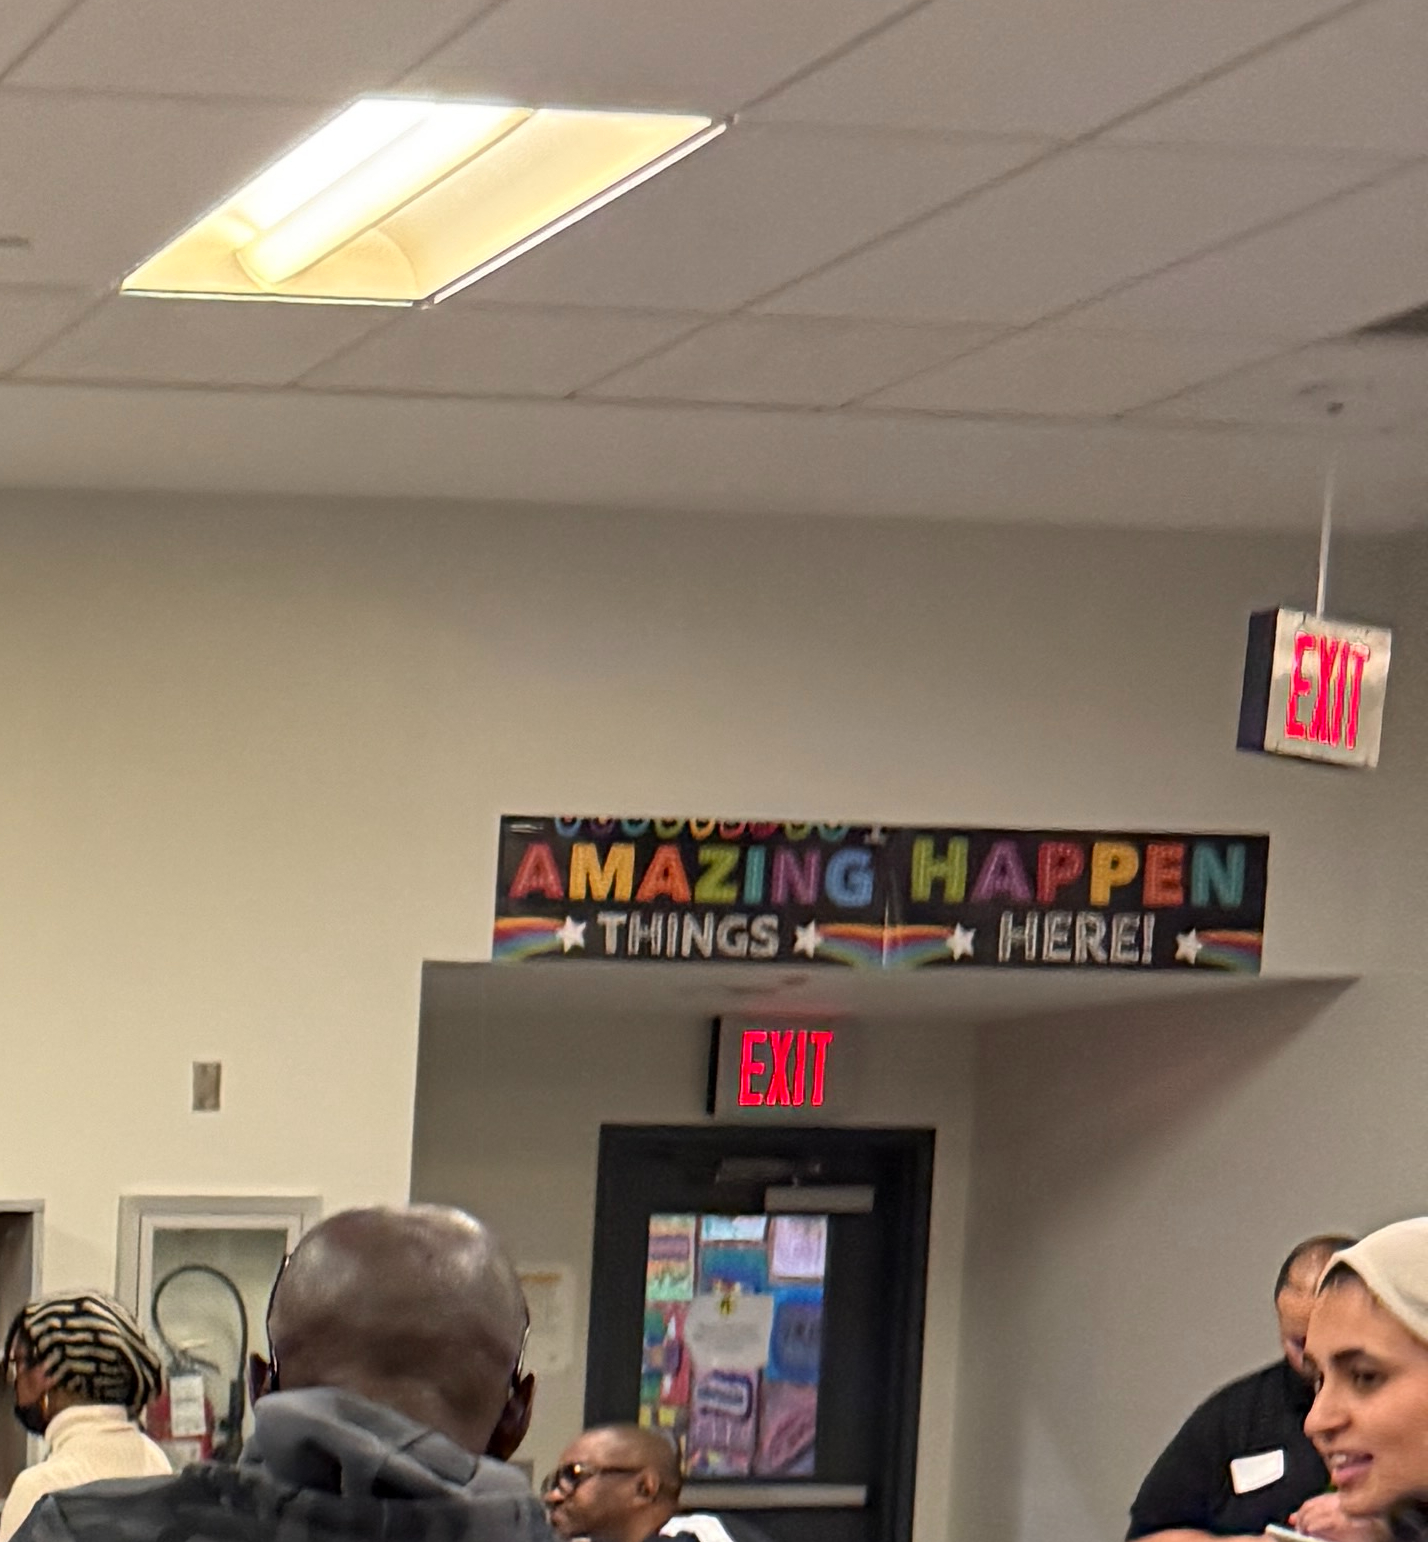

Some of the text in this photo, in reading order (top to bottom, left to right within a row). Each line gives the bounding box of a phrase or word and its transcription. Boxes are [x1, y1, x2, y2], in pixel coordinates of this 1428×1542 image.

[1285, 630, 1370, 749] EXIT
[508, 835, 1246, 908] AMAZING HAPPEN
[597, 910, 1156, 964] THINGS HERE!
[738, 1029, 834, 1107] EXIT
